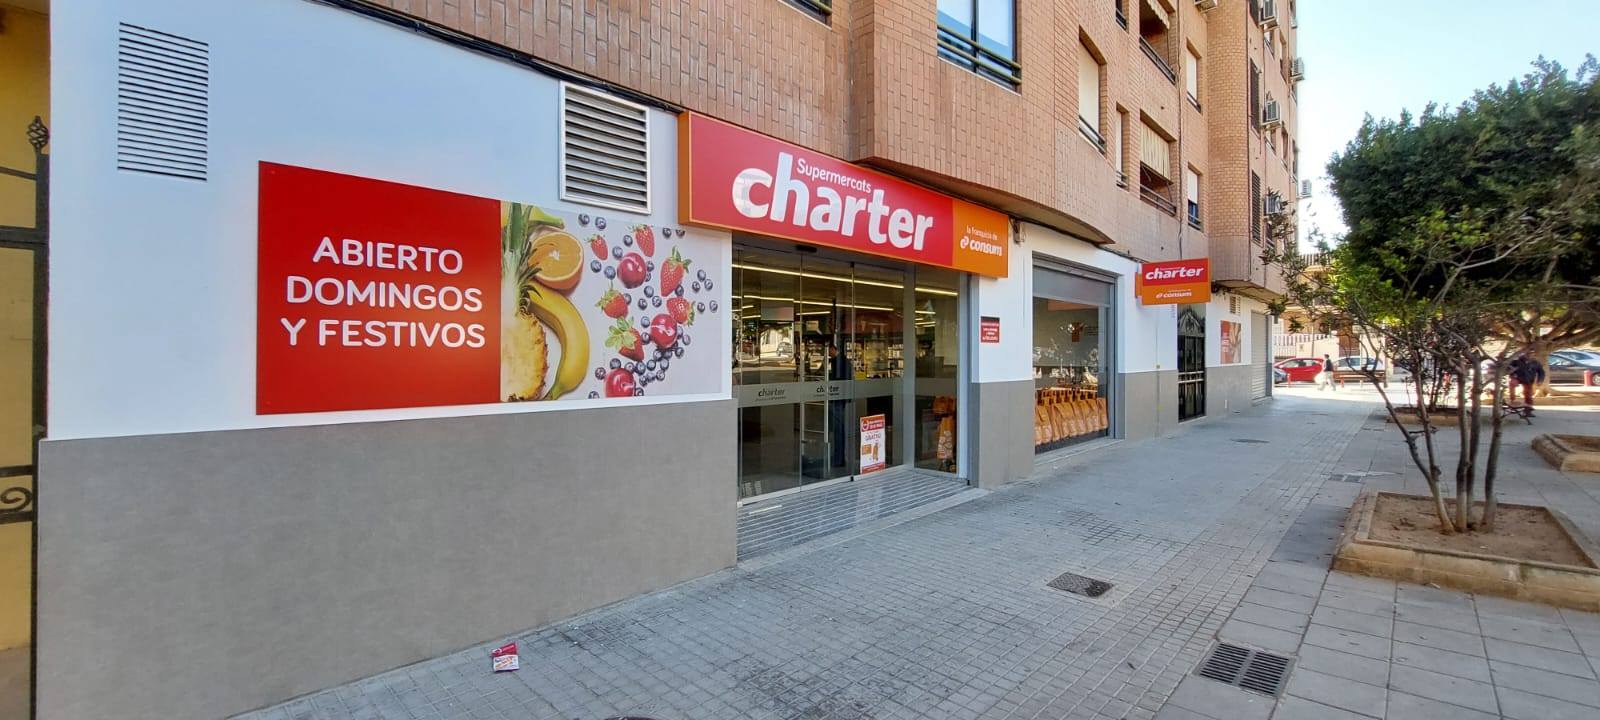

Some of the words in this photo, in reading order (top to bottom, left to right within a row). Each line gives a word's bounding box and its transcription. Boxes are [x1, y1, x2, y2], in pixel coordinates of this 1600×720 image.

[796, 158, 872, 194] Supermercats
[732, 152, 933, 251] charter
[312, 236, 463, 275] ABIERTO
[970, 239, 1003, 257] consum
[1145, 266, 1205, 280] charter
[286, 275, 483, 313] DOMINGOS
[280, 317, 307, 346] Y
[318, 319, 486, 349] FESTIVOS
[758, 387, 785, 397] charter
